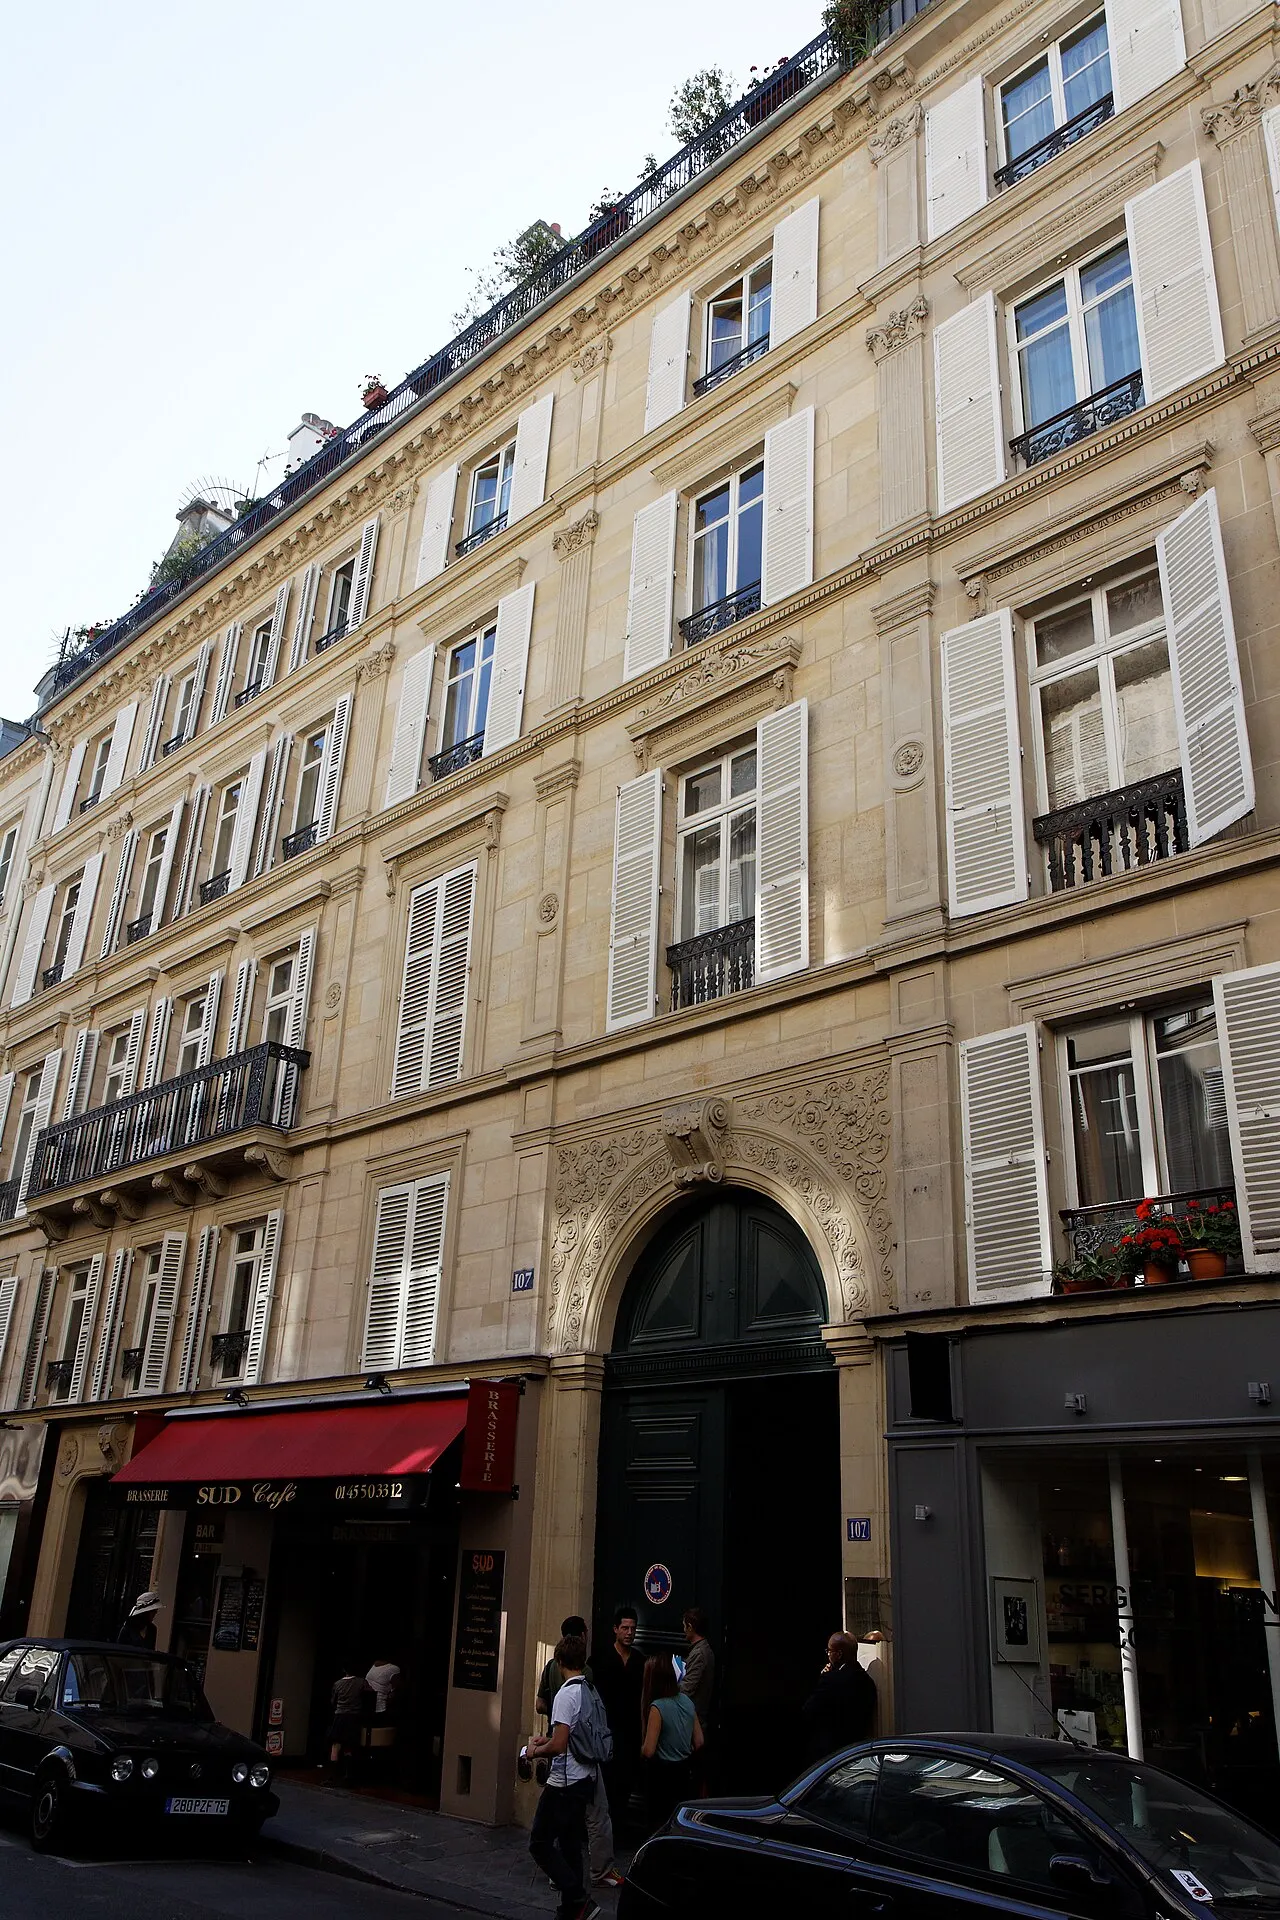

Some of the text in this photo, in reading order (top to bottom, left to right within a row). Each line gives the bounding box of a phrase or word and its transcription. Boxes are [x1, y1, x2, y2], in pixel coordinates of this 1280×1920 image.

[514, 1272, 532, 1289] 107
[483, 1390, 500, 1482] BRASSERIE
[127, 1489, 169, 1502] BRASSERIE
[197, 1482, 298, 1510] SUD Café
[196, 1524, 215, 1538] BAR
[850, 1521, 867, 1538] 107
[472, 1554, 494, 1571] SUD
[173, 1799, 227, 1813] 280 PZF 75
